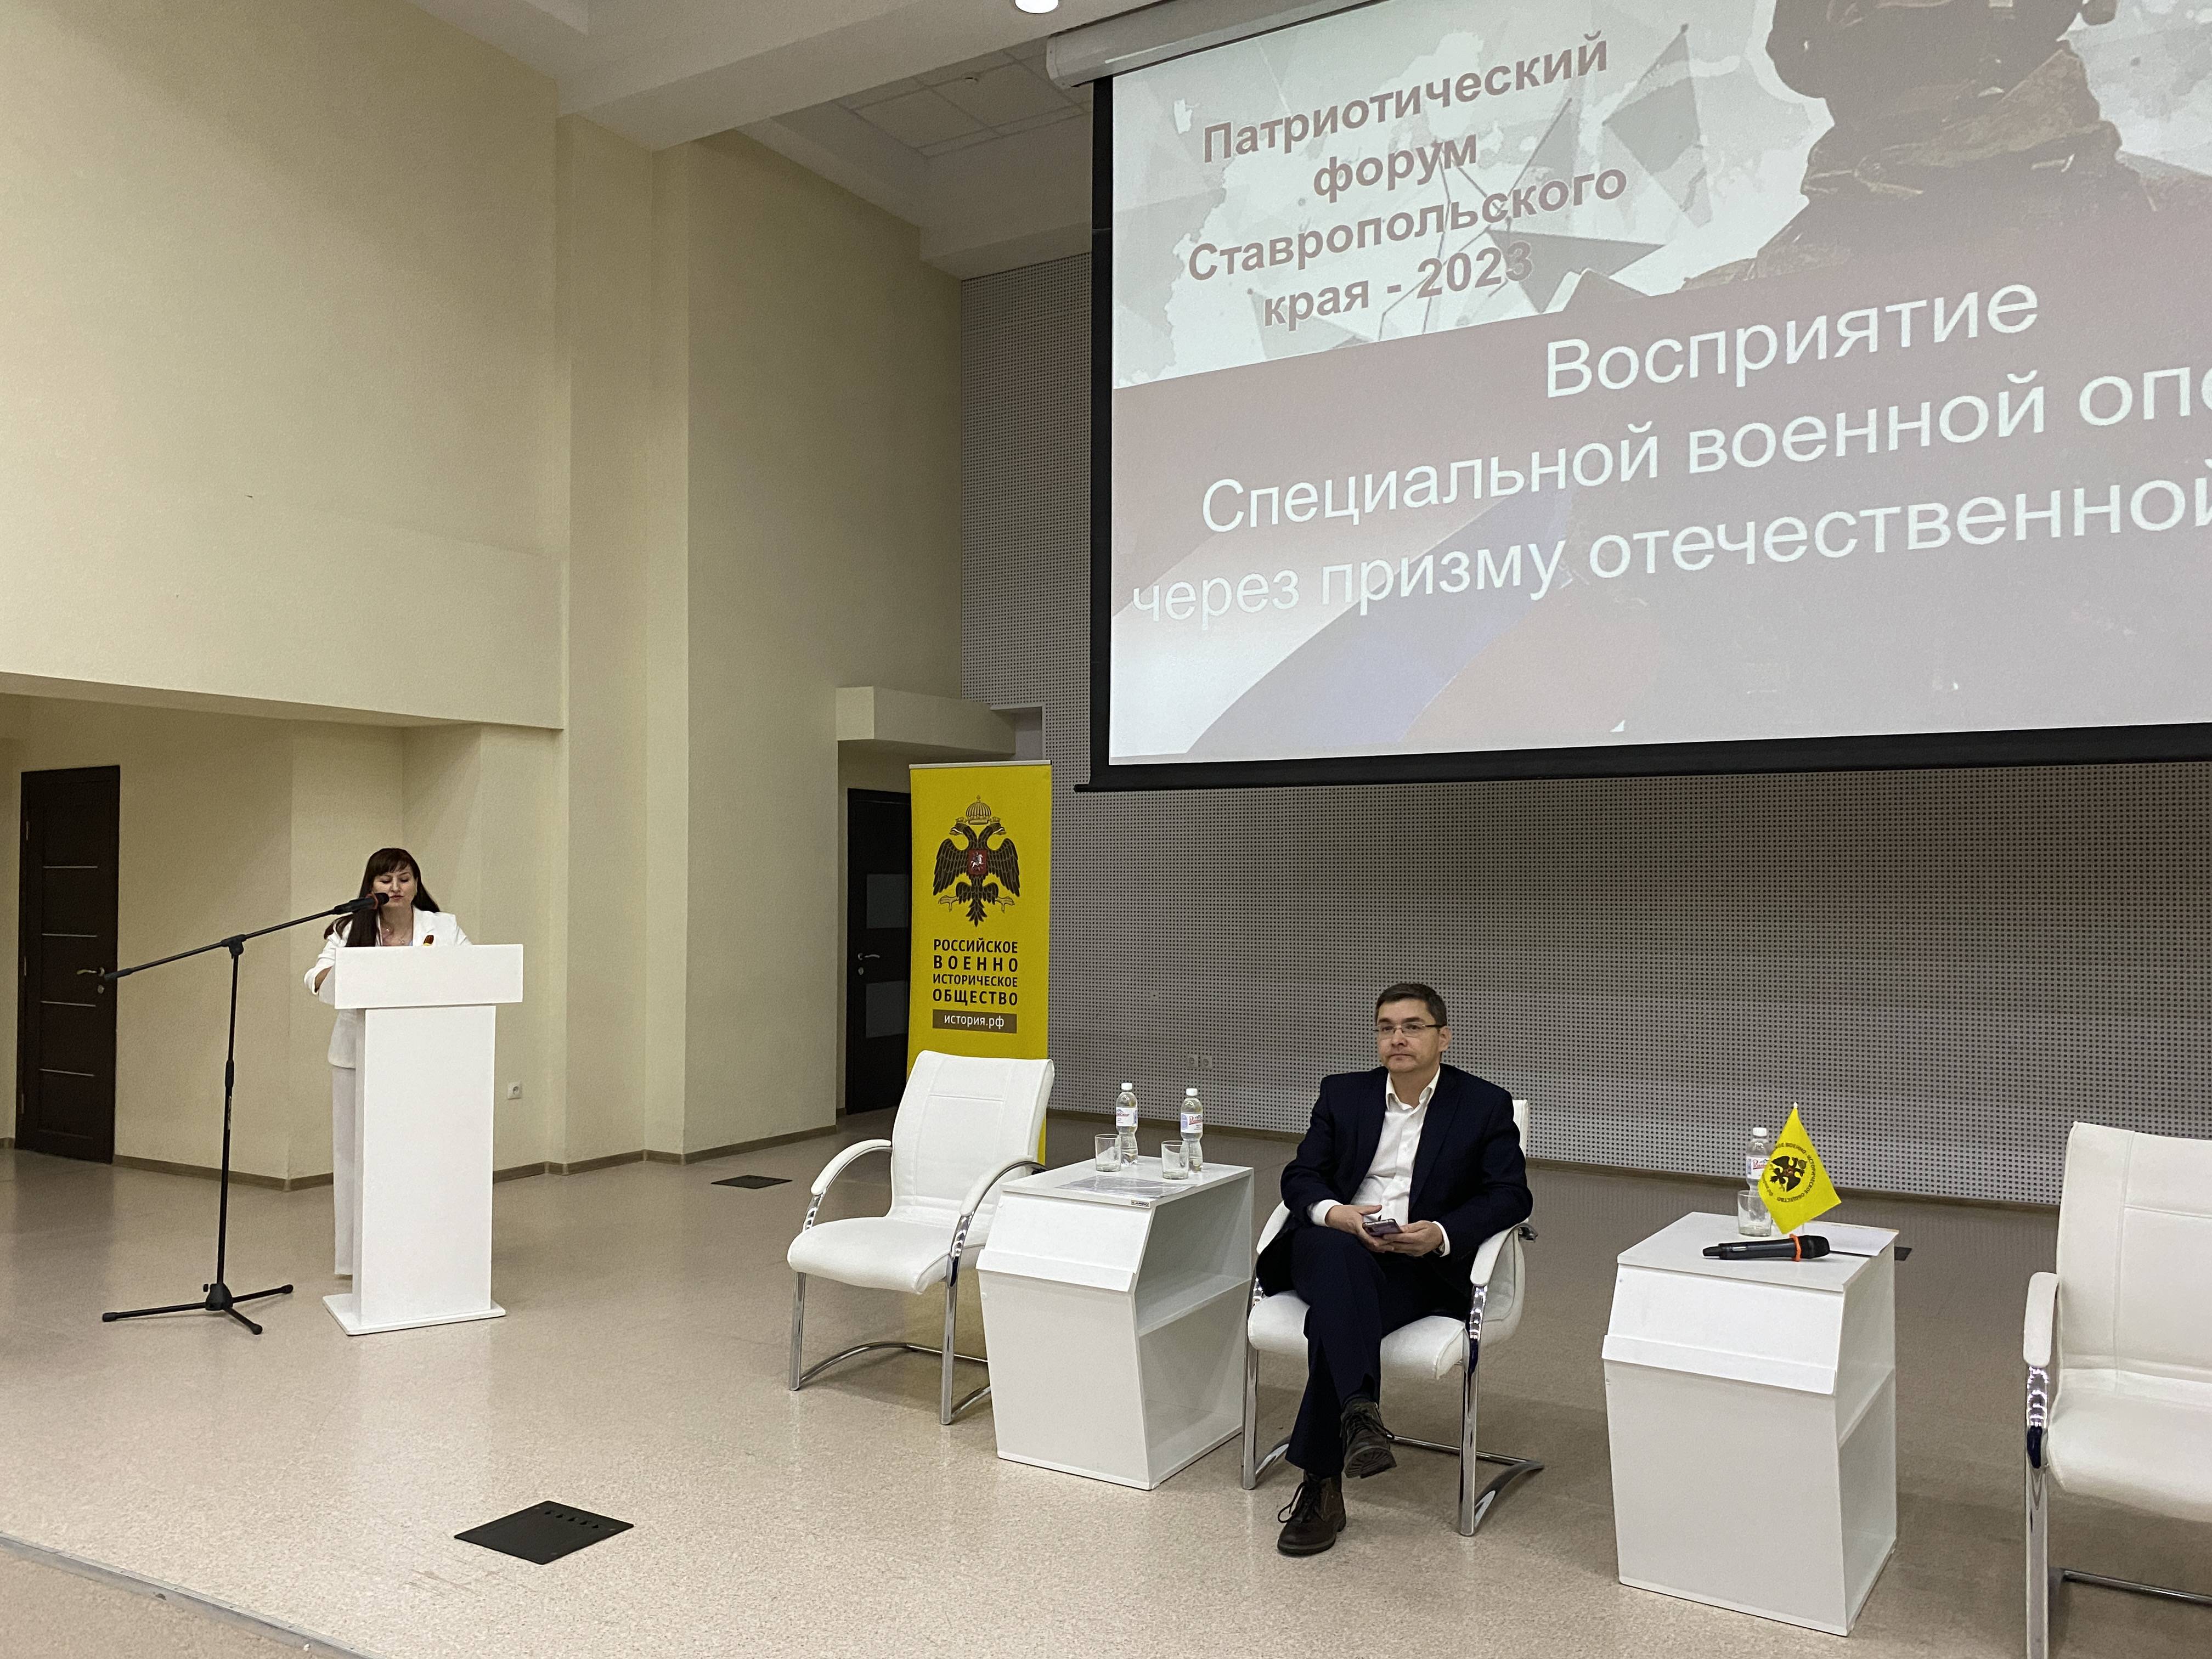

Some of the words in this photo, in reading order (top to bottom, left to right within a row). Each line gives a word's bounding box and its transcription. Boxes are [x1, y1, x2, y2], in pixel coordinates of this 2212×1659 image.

[1204, 30, 1607, 163] Патриотический
[1313, 134, 1477, 202] форум
[1188, 169, 1627, 281] Ставропольского
[1264, 280, 1369, 330] края
[1417, 241, 1532, 299] 2023
[1547, 283, 2038, 398] Восприятие
[1202, 421, 1658, 533] Специальной
[1688, 370, 2045, 473] военной
[2079, 366, 2212, 426] оп
[1132, 568, 1299, 630] через
[1321, 538, 1565, 615] призму
[933, 955, 1018, 972] ВОЕННО
[933, 973, 1018, 988] ИСТОРИЧЕСКОЕ
[934, 938, 1018, 954] РОССИЙСКОЕ
[933, 989, 1018, 1006] ОБЩЕСТВО
[944, 1013, 1005, 1029] история.рф
